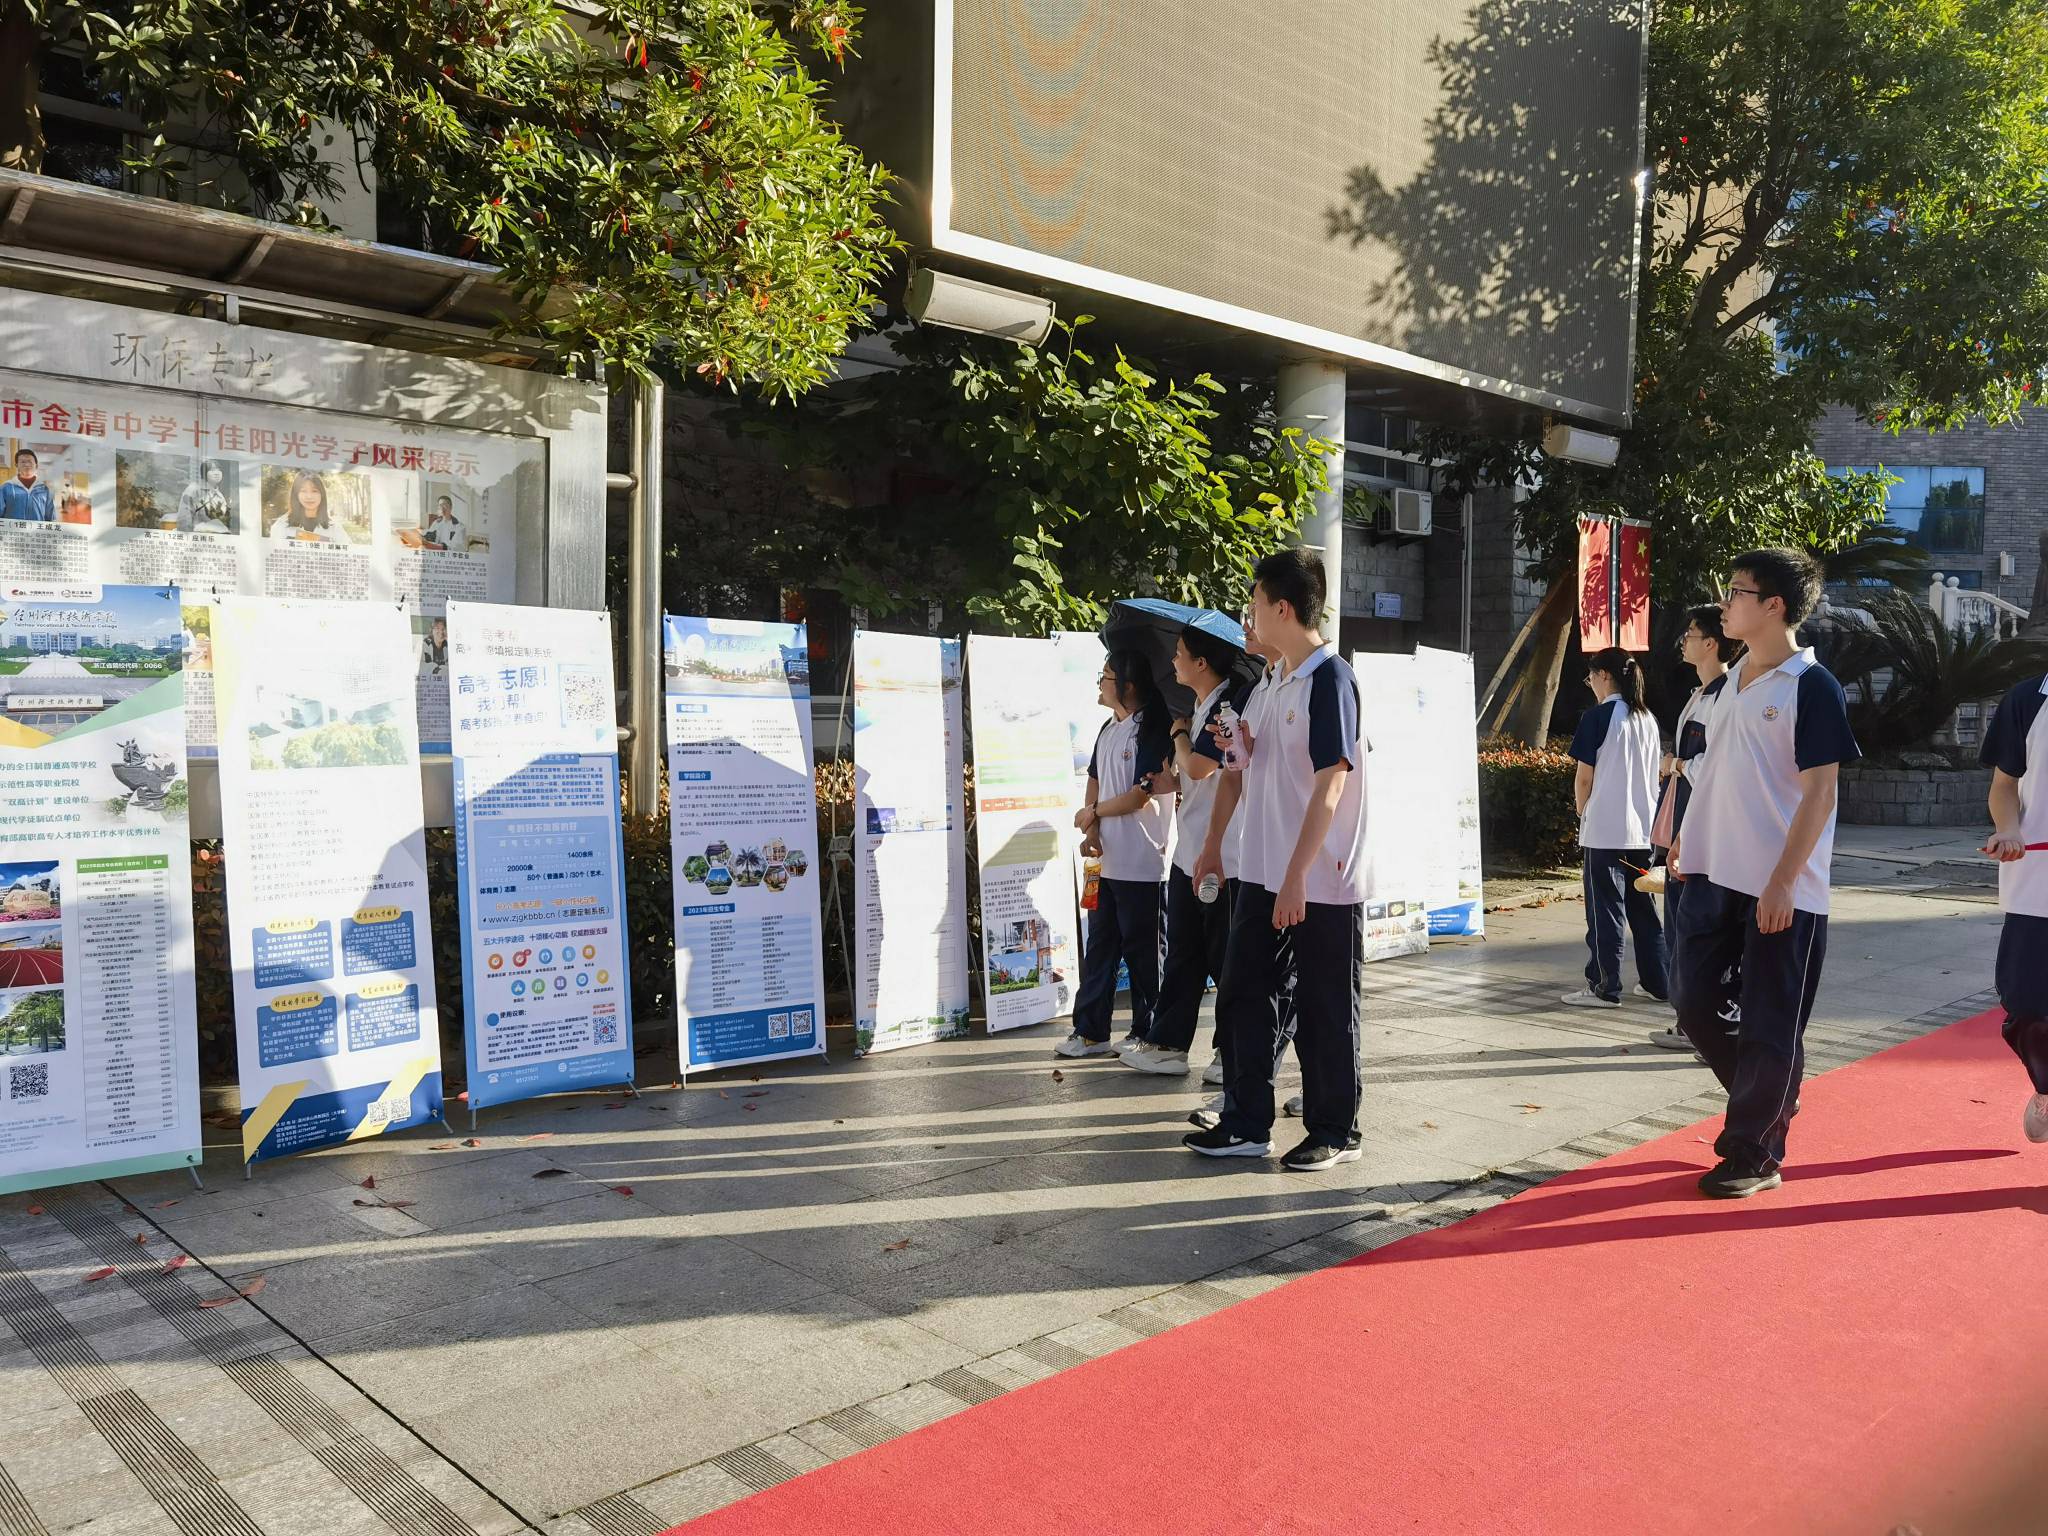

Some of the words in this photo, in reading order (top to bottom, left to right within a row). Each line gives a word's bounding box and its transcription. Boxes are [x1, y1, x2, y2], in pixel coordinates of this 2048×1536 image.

[110, 331, 275, 392] 环保专栏
[1, 399, 481, 477] 市金清中学十佳阳光学子风采展示
